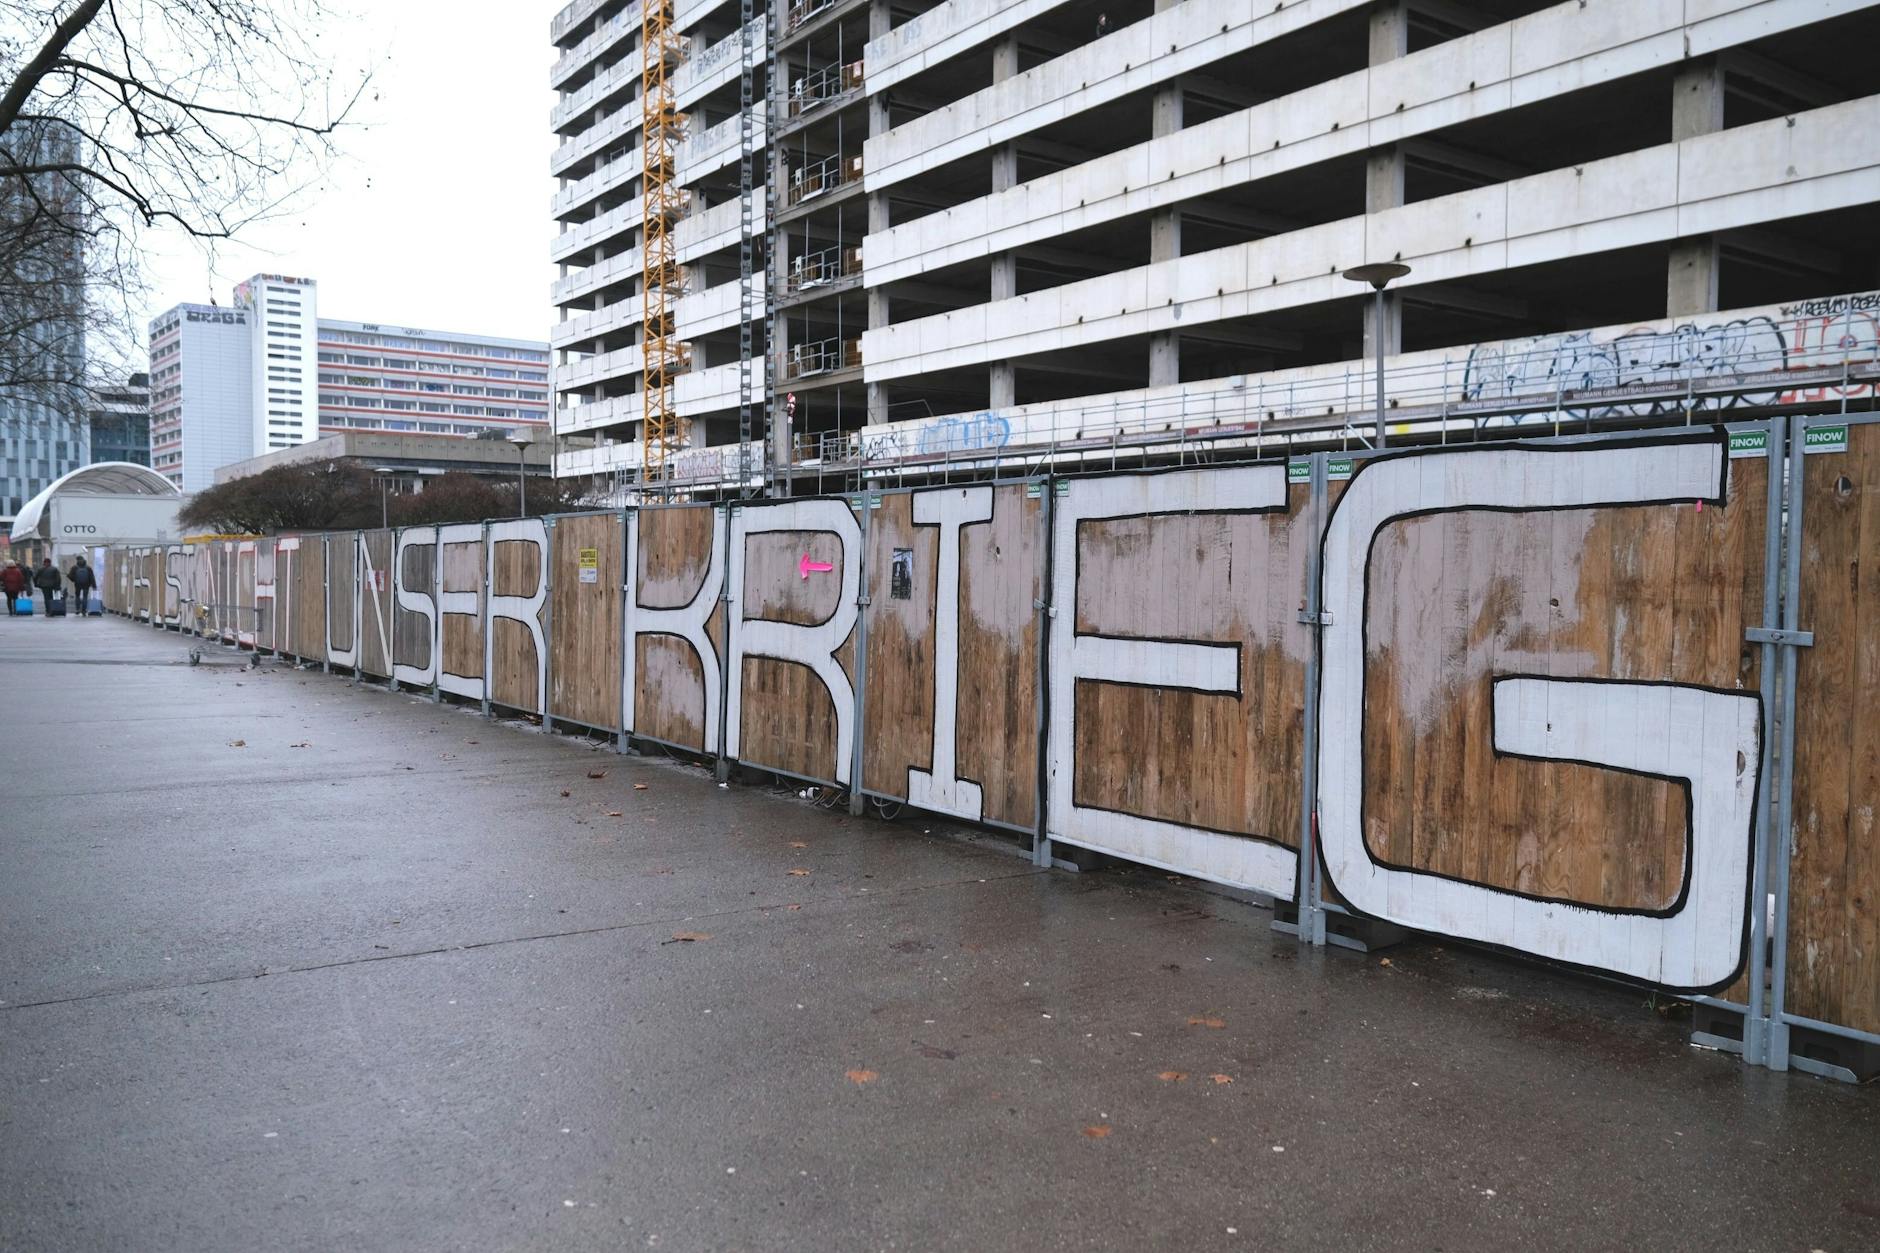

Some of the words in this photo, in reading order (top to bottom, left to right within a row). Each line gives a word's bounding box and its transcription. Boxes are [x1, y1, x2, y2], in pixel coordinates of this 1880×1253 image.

[1730, 437, 1765, 448] FINOW
[1807, 432, 1843, 443] FINOW
[1289, 467, 1309, 476] FINOW
[1329, 464, 1351, 473] FINOW
[64, 524, 96, 534] OTTO
[325, 516, 549, 717] UNSER
[622, 436, 1765, 994] KRIEG
